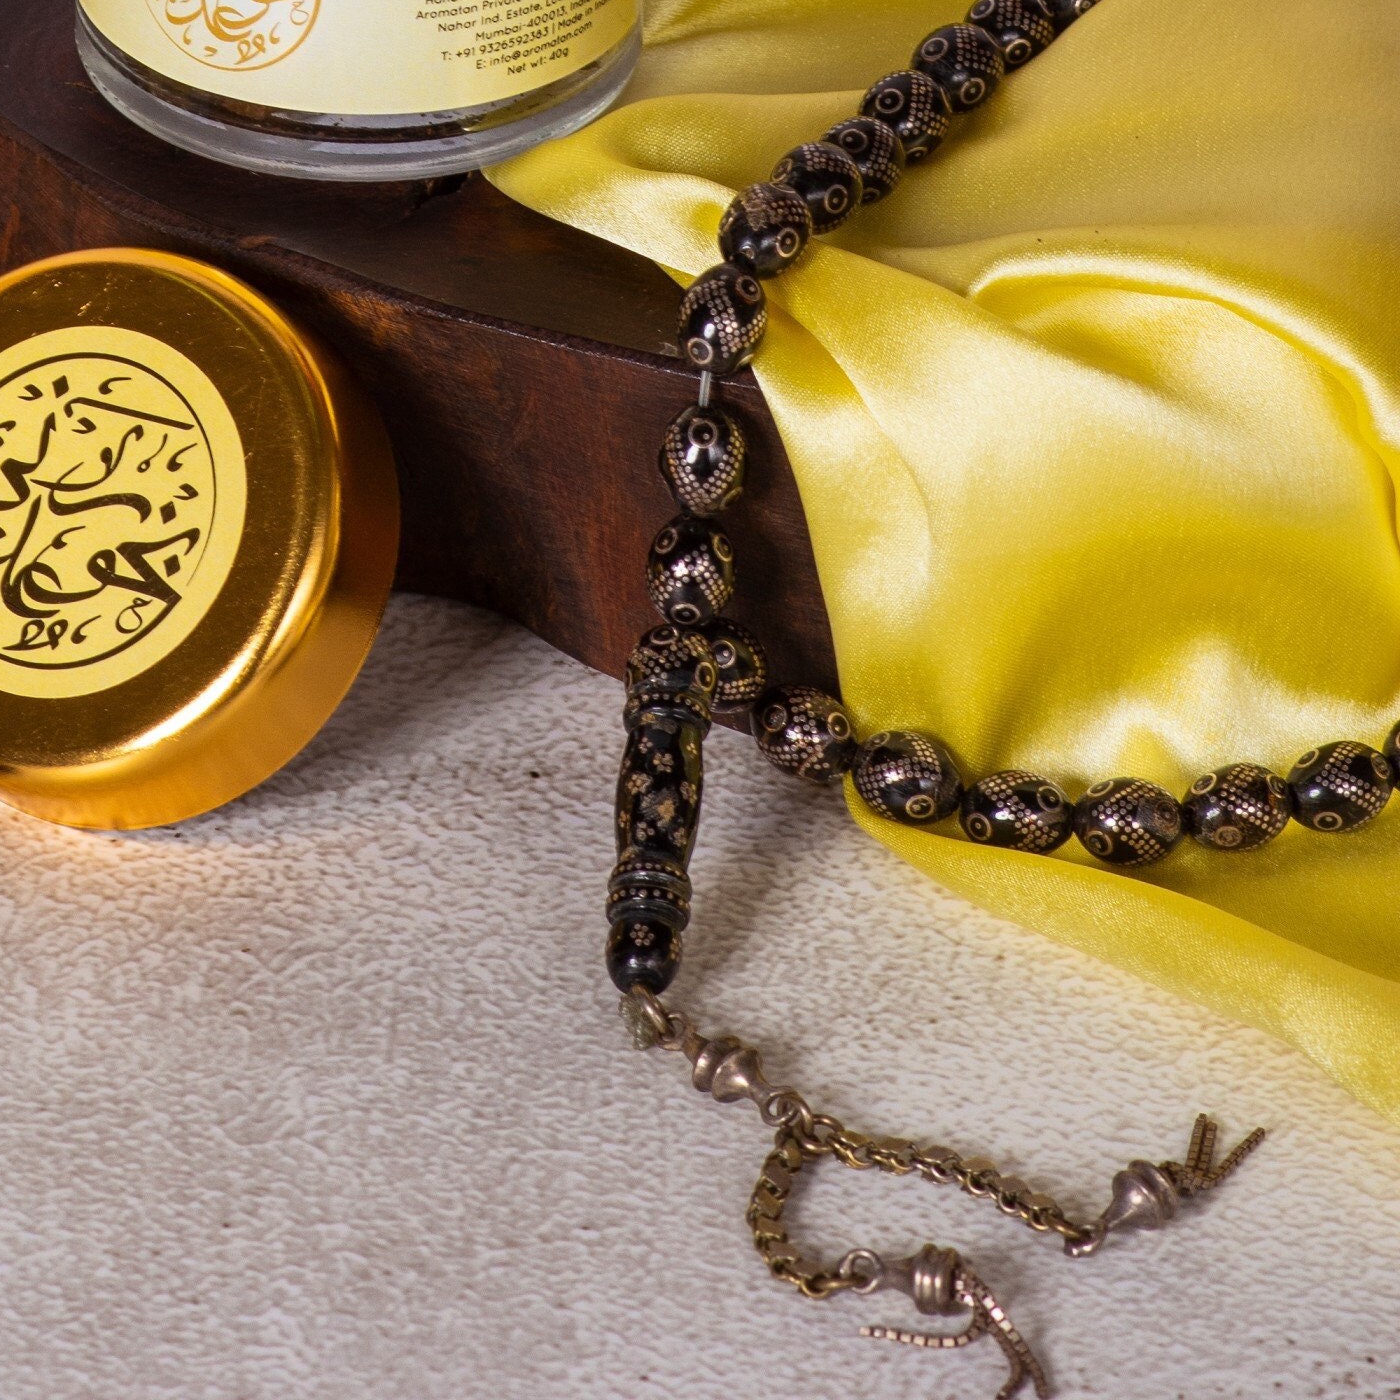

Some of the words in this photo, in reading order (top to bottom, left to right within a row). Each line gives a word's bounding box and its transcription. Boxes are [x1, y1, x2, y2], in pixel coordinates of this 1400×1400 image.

[415, 5, 478, 20] Aromatan
[437, 20, 477, 33] Nahar
[440, 50, 452, 61] T:
[456, 46, 476, 58] +91
[479, 26, 549, 55] 9326592383
[558, 12, 583, 31] Made
[585, 7, 593, 17] in
[476, 58, 487, 70] E:
[507, 62, 526, 76] Net
[549, 47, 570, 61] 40g
